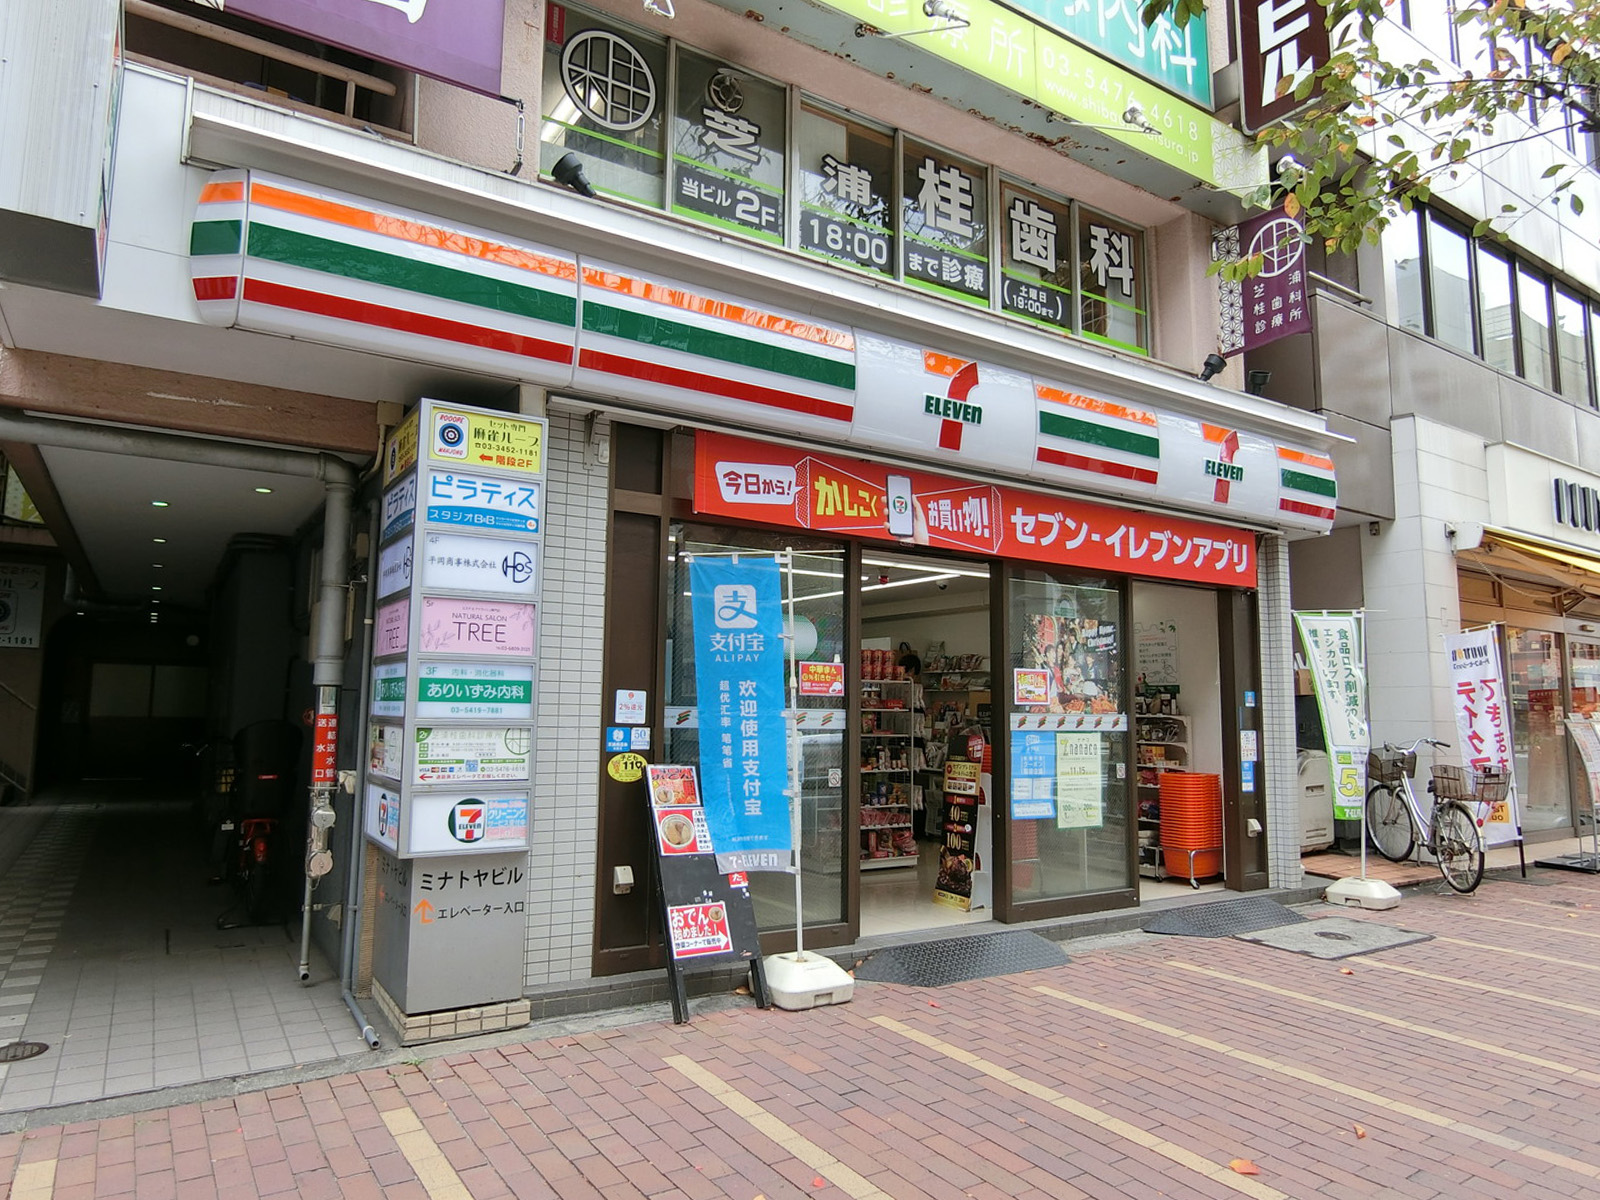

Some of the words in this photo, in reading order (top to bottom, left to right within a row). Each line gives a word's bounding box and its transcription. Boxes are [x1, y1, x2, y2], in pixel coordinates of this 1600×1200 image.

[810, 218, 888, 265] 18:00
[908, 251, 984, 292] まで診療
[1019, 285, 1047, 304] 土曜日
[1012, 295, 1054, 319] 19:00まで
[490, 420, 526, 433] セット専門
[482, 444, 538, 457] 03-3452-1181
[495, 455, 533, 468] 階段2F
[432, 474, 536, 509] ピラティス
[814, 475, 878, 519] かしこく
[452, 612, 483, 620] NATURAL
[485, 614, 508, 622] SALON
[452, 621, 507, 643] TREE
[709, 632, 764, 653] 支付宝
[715, 653, 760, 662] ALIPAY
[426, 667, 437, 675] 3F
[427, 683, 525, 699] ありいずみ内科
[738, 680, 762, 816] 欢迎使用支付宝
[420, 867, 524, 890] ミナトヤビル
[438, 901, 525, 919] エレベーター入口
[672, 907, 710, 927] おでん
